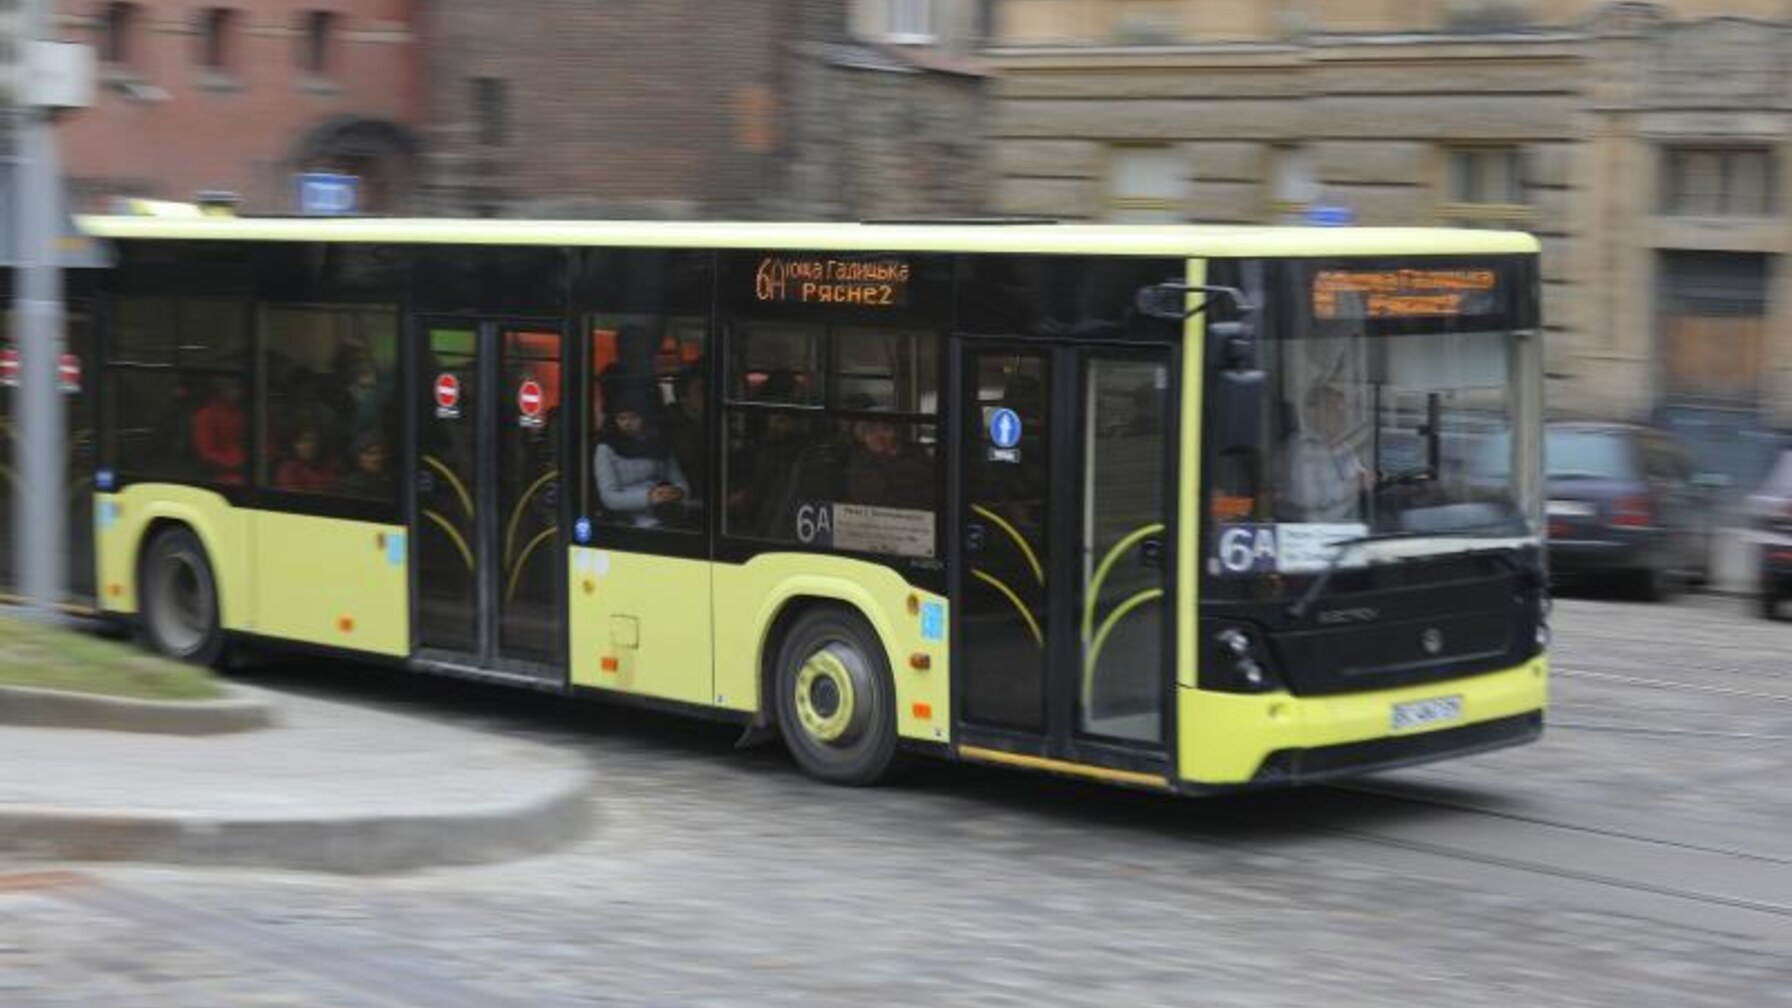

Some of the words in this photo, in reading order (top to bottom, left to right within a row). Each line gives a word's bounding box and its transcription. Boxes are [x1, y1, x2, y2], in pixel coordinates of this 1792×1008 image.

[756, 257, 785, 300] 6А
[796, 504, 831, 543] 6А
[1219, 527, 1275, 571] 6А
